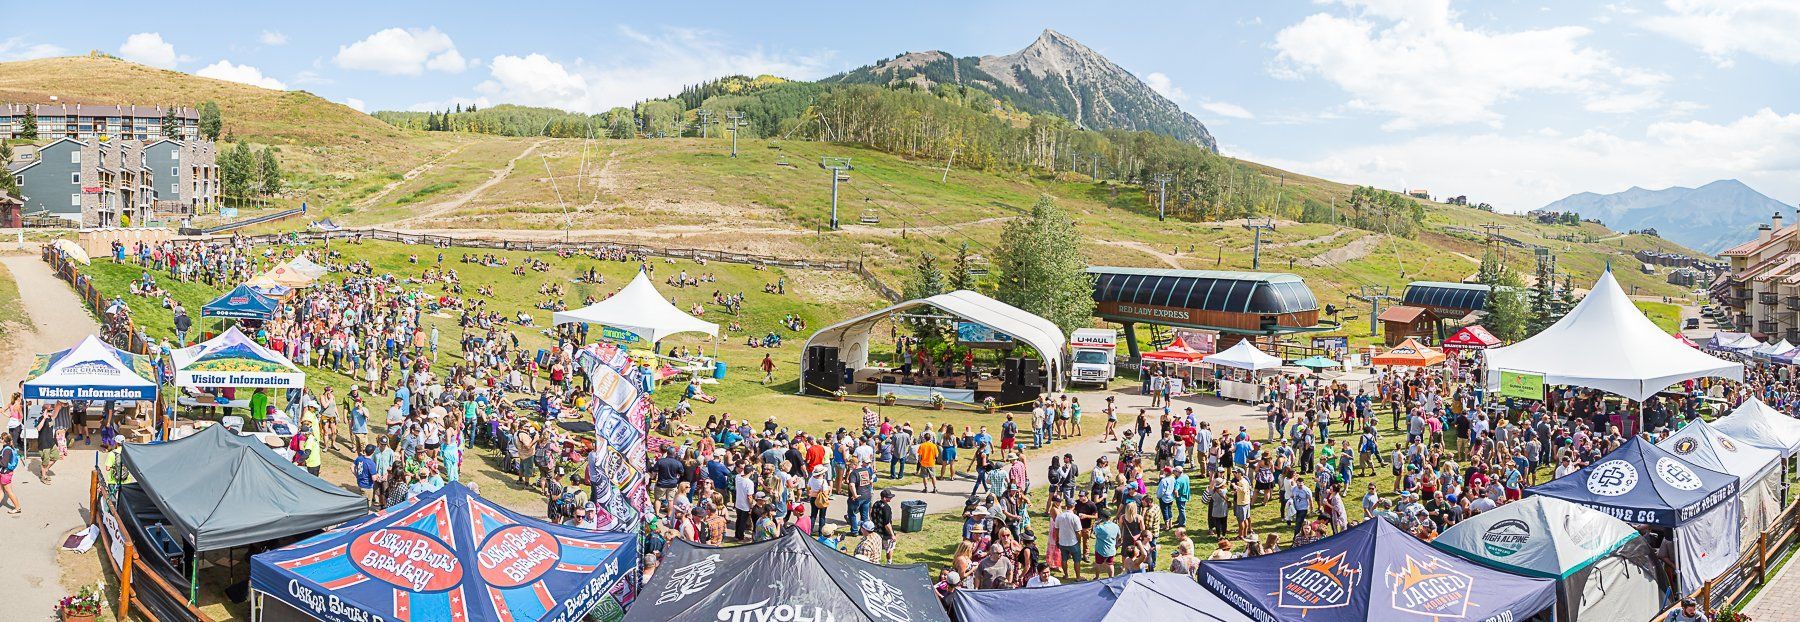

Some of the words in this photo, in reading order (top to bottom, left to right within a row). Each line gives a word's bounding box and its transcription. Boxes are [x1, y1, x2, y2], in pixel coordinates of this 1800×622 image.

[1119, 305, 1132, 313] RED
[1134, 307, 1152, 315] LADY
[1154, 309, 1190, 320] EXPRESS
[191, 374, 227, 384] Visitor
[229, 375, 290, 385] Information
[38, 387, 75, 398] Visitor
[77, 388, 142, 398] Information
[1585, 503, 1633, 522] EWING
[1637, 510, 1660, 523] CO.
[1481, 532, 1502, 543] HIGH
[1500, 534, 1531, 544] ALPINE
[1285, 567, 1345, 604] JAGGED
[1285, 582, 1321, 605] MOUNTAIN
[1402, 575, 1466, 608] JAGGED
[1423, 591, 1463, 611] MOUNTAIN
